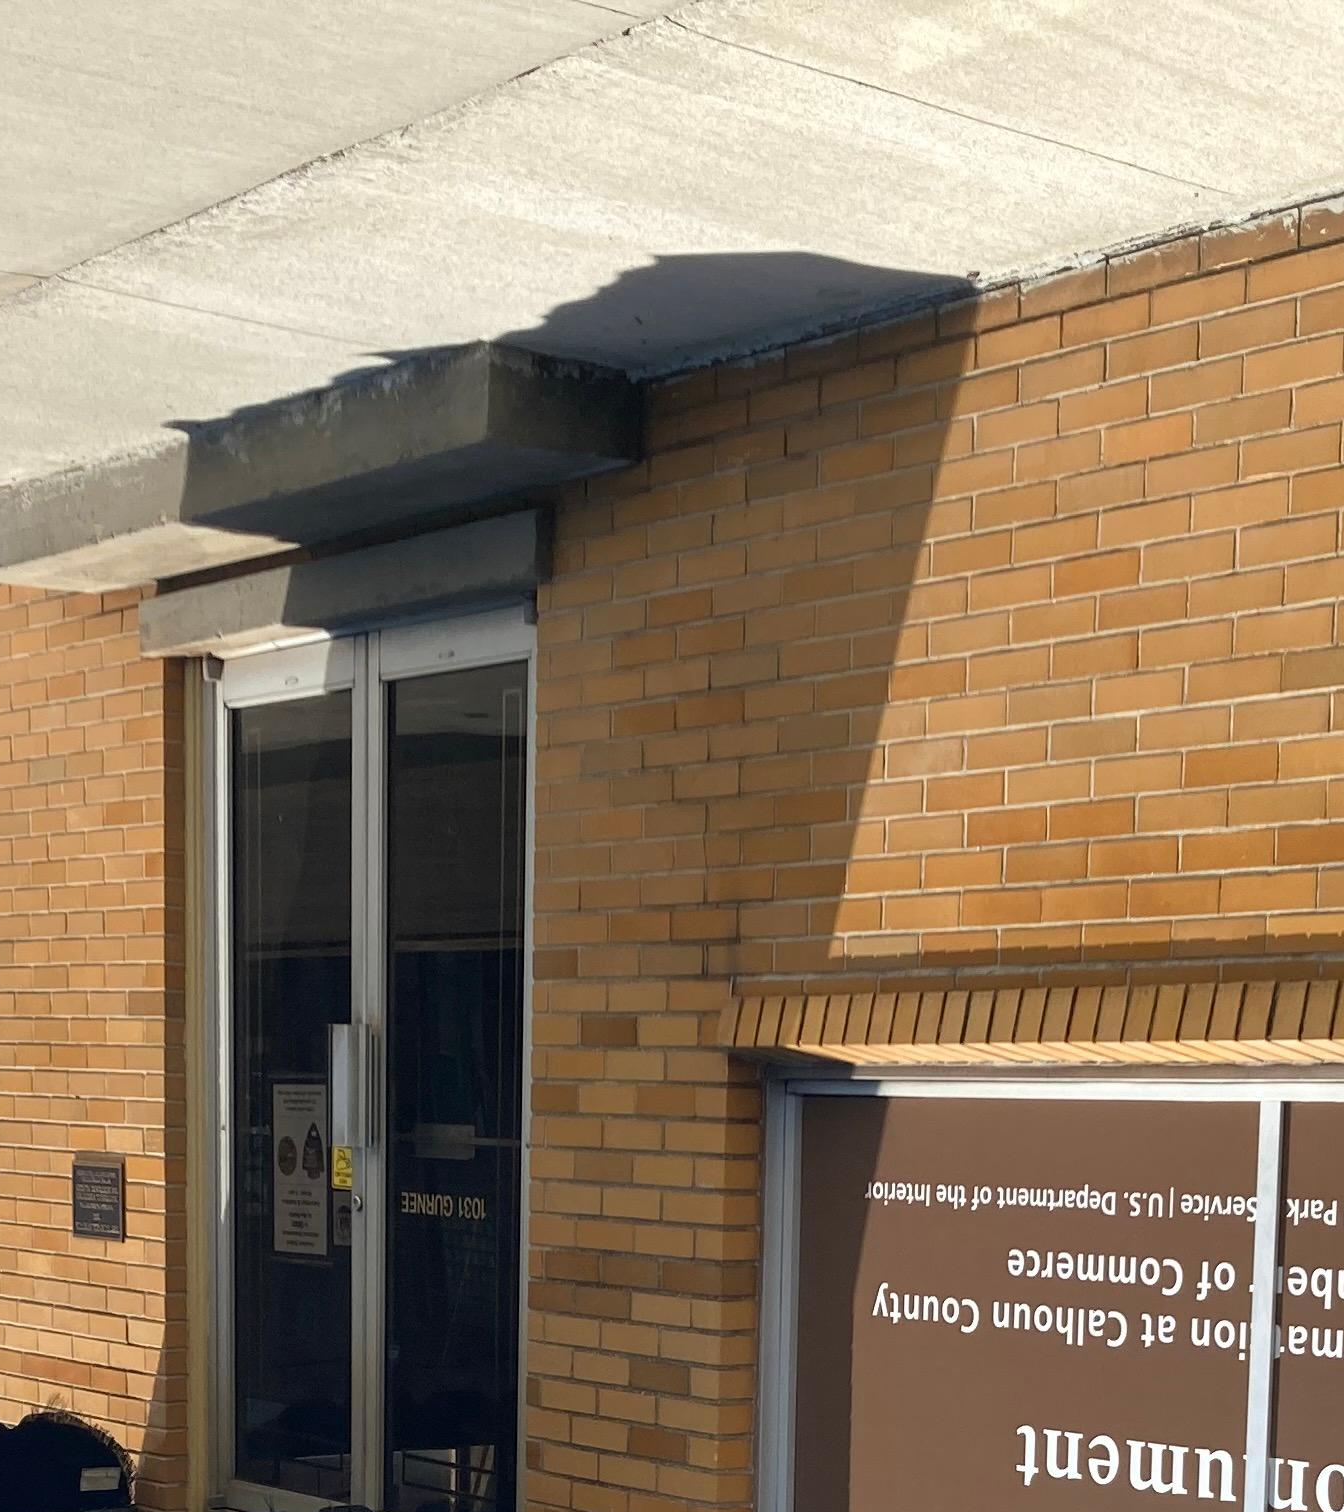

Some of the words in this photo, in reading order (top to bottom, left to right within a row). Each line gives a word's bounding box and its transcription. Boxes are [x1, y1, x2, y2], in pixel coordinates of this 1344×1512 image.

[401, 1192, 453, 1217] GURNEE
[458, 1196, 486, 1220] 1031
[864, 1180, 931, 1207] Interior
[936, 1183, 967, 1210] the
[970, 1185, 992, 1210] of
[996, 1183, 1117, 1216] Department
[1123, 1191, 1164, 1218] U.S.
[1180, 1193, 1258, 1222] Service
[1286, 1197, 1338, 1226] Park
[1007, 1248, 1184, 1297] Commerce
[1196, 1260, 1236, 1301] of
[871, 1281, 980, 1334] County
[992, 1300, 1128, 1348] Calhoun
[1140, 1313, 1177, 1348] at
